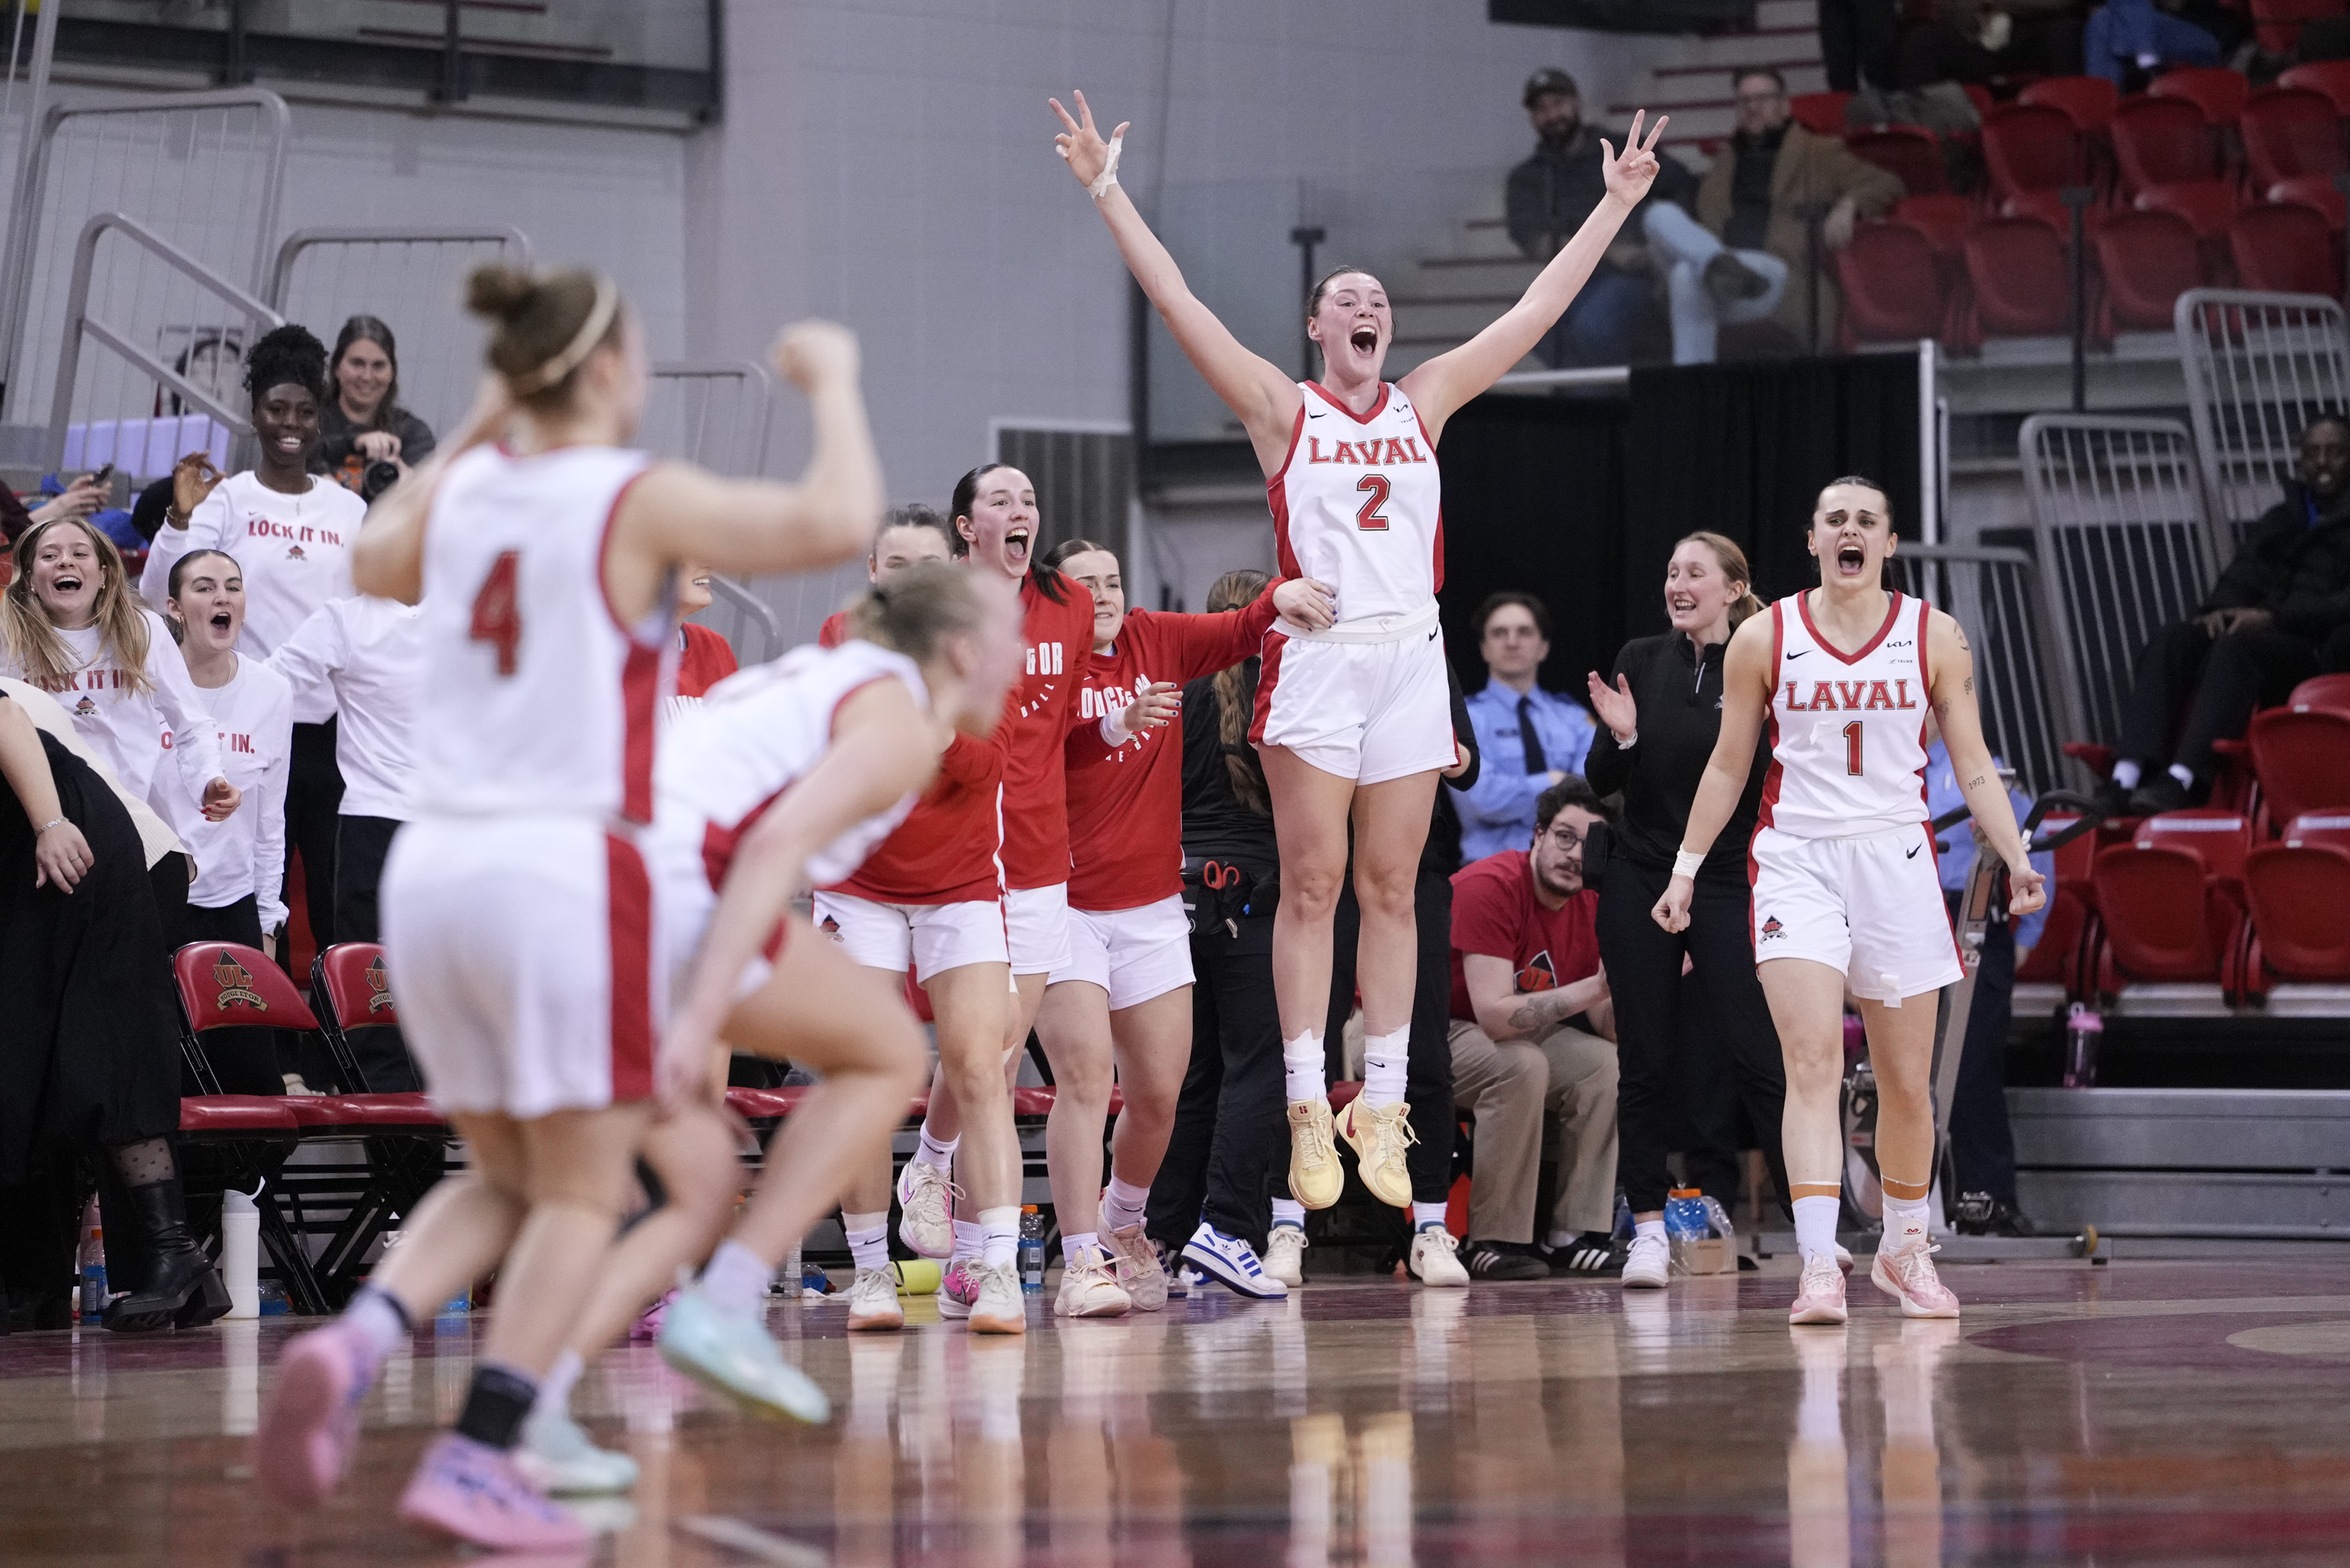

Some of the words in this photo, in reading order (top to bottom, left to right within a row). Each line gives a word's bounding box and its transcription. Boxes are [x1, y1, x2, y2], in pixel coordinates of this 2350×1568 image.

[1308, 435, 1428, 466] LAVAL
[1356, 473, 1391, 531] 2
[247, 519, 294, 540] LOCK
[299, 525, 314, 542] IT
[320, 530, 344, 549] IN.
[469, 549, 521, 677] 4
[1038, 641, 1063, 676] OR
[86, 669, 105, 690] IT
[1785, 678, 1917, 712] LAVAL
[231, 733, 255, 755] IN.
[1842, 720, 1864, 777] 1
[1968, 775, 1986, 790] 1973
[212, 964, 254, 988] UL
